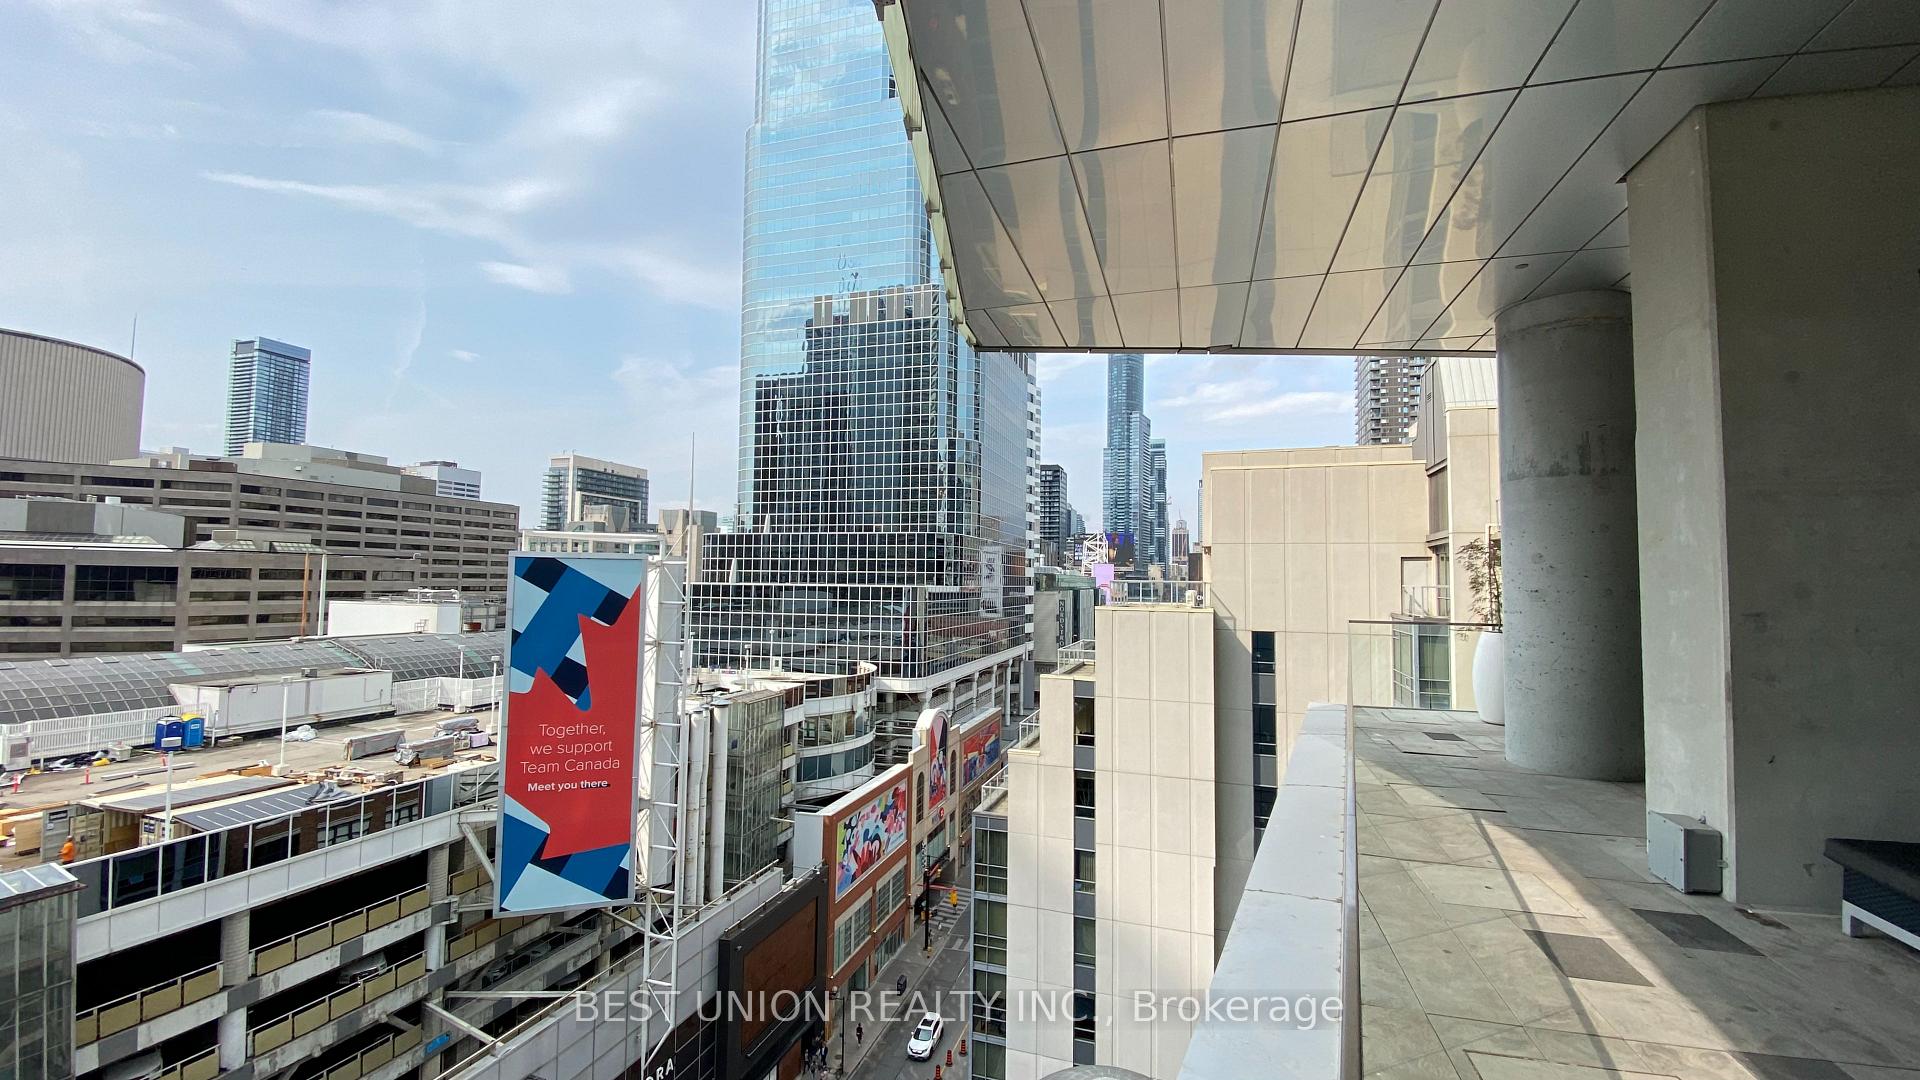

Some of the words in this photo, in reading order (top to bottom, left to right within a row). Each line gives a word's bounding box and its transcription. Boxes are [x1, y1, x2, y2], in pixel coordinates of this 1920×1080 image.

[539, 723, 606, 738] Together,
[530, 745, 552, 755] we
[557, 741, 613, 755] support
[520, 761, 560, 774] Team
[564, 757, 620, 772] Canada
[527, 783, 556, 792] Meet
[558, 783, 577, 792] you
[580, 780, 608, 789] there
[646, 1058, 674, 1080] RA
